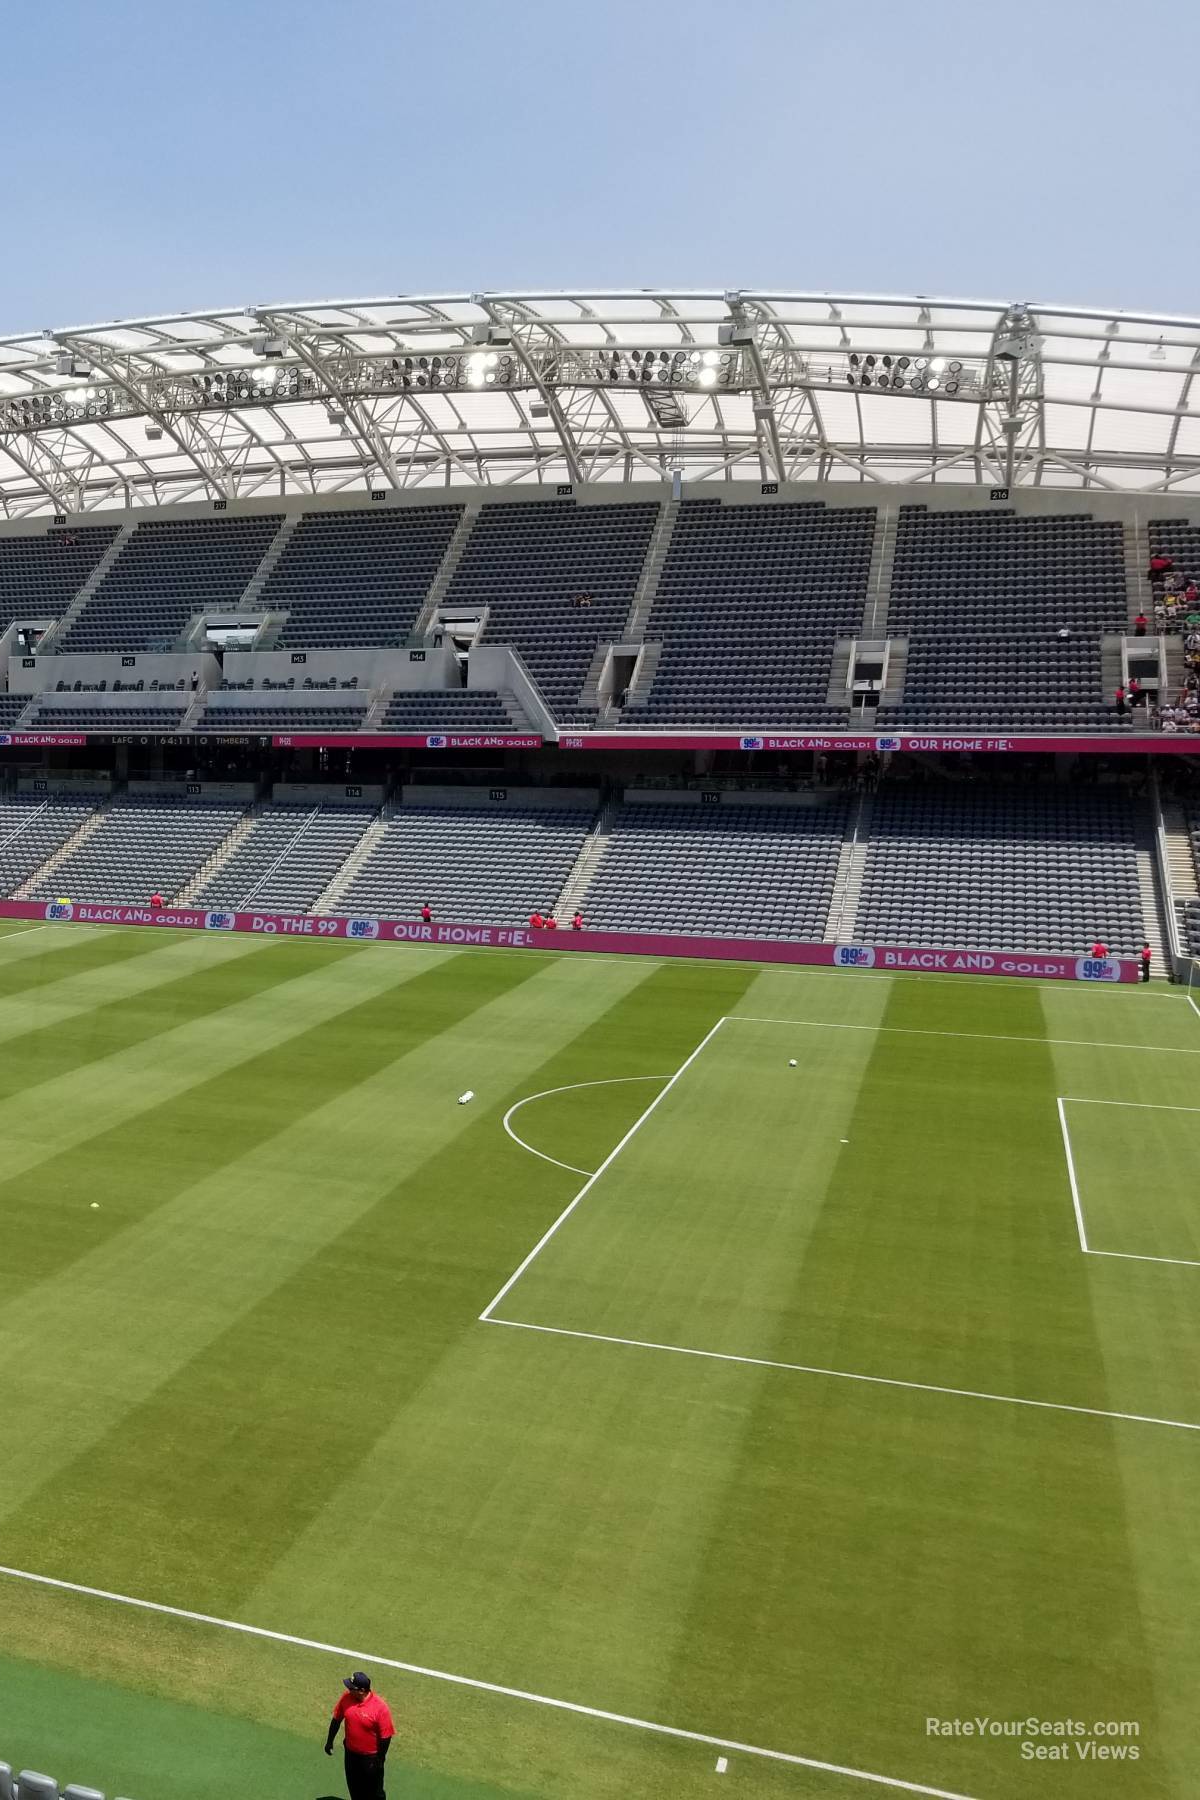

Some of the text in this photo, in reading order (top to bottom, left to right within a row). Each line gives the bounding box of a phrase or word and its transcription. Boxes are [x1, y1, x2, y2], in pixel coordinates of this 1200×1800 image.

[558, 485, 571, 494] 214
[763, 485, 777, 493] 215
[373, 491, 384, 500] 213
[992, 490, 1007, 499] 216
[215, 501, 226, 509] 212
[55, 516, 65, 524] 211
[484, 737, 504, 745] AND
[769, 739, 805, 748] BLACK
[807, 738, 832, 747] AND
[909, 739, 938, 749] OUR
[943, 740, 983, 750] HOME
[35, 781, 46, 789] 112
[188, 784, 199, 792] 113
[347, 787, 359, 795] 114
[492, 790, 504, 798] 115
[704, 793, 718, 801] 116
[79, 908, 198, 925] BLACK AND GOLD!
[281, 918, 314, 932] THE
[318, 921, 338, 934] 99
[394, 925, 533, 945] OUR HOME FIEL
[885, 952, 1065, 974] BLACK AND GOLD!
